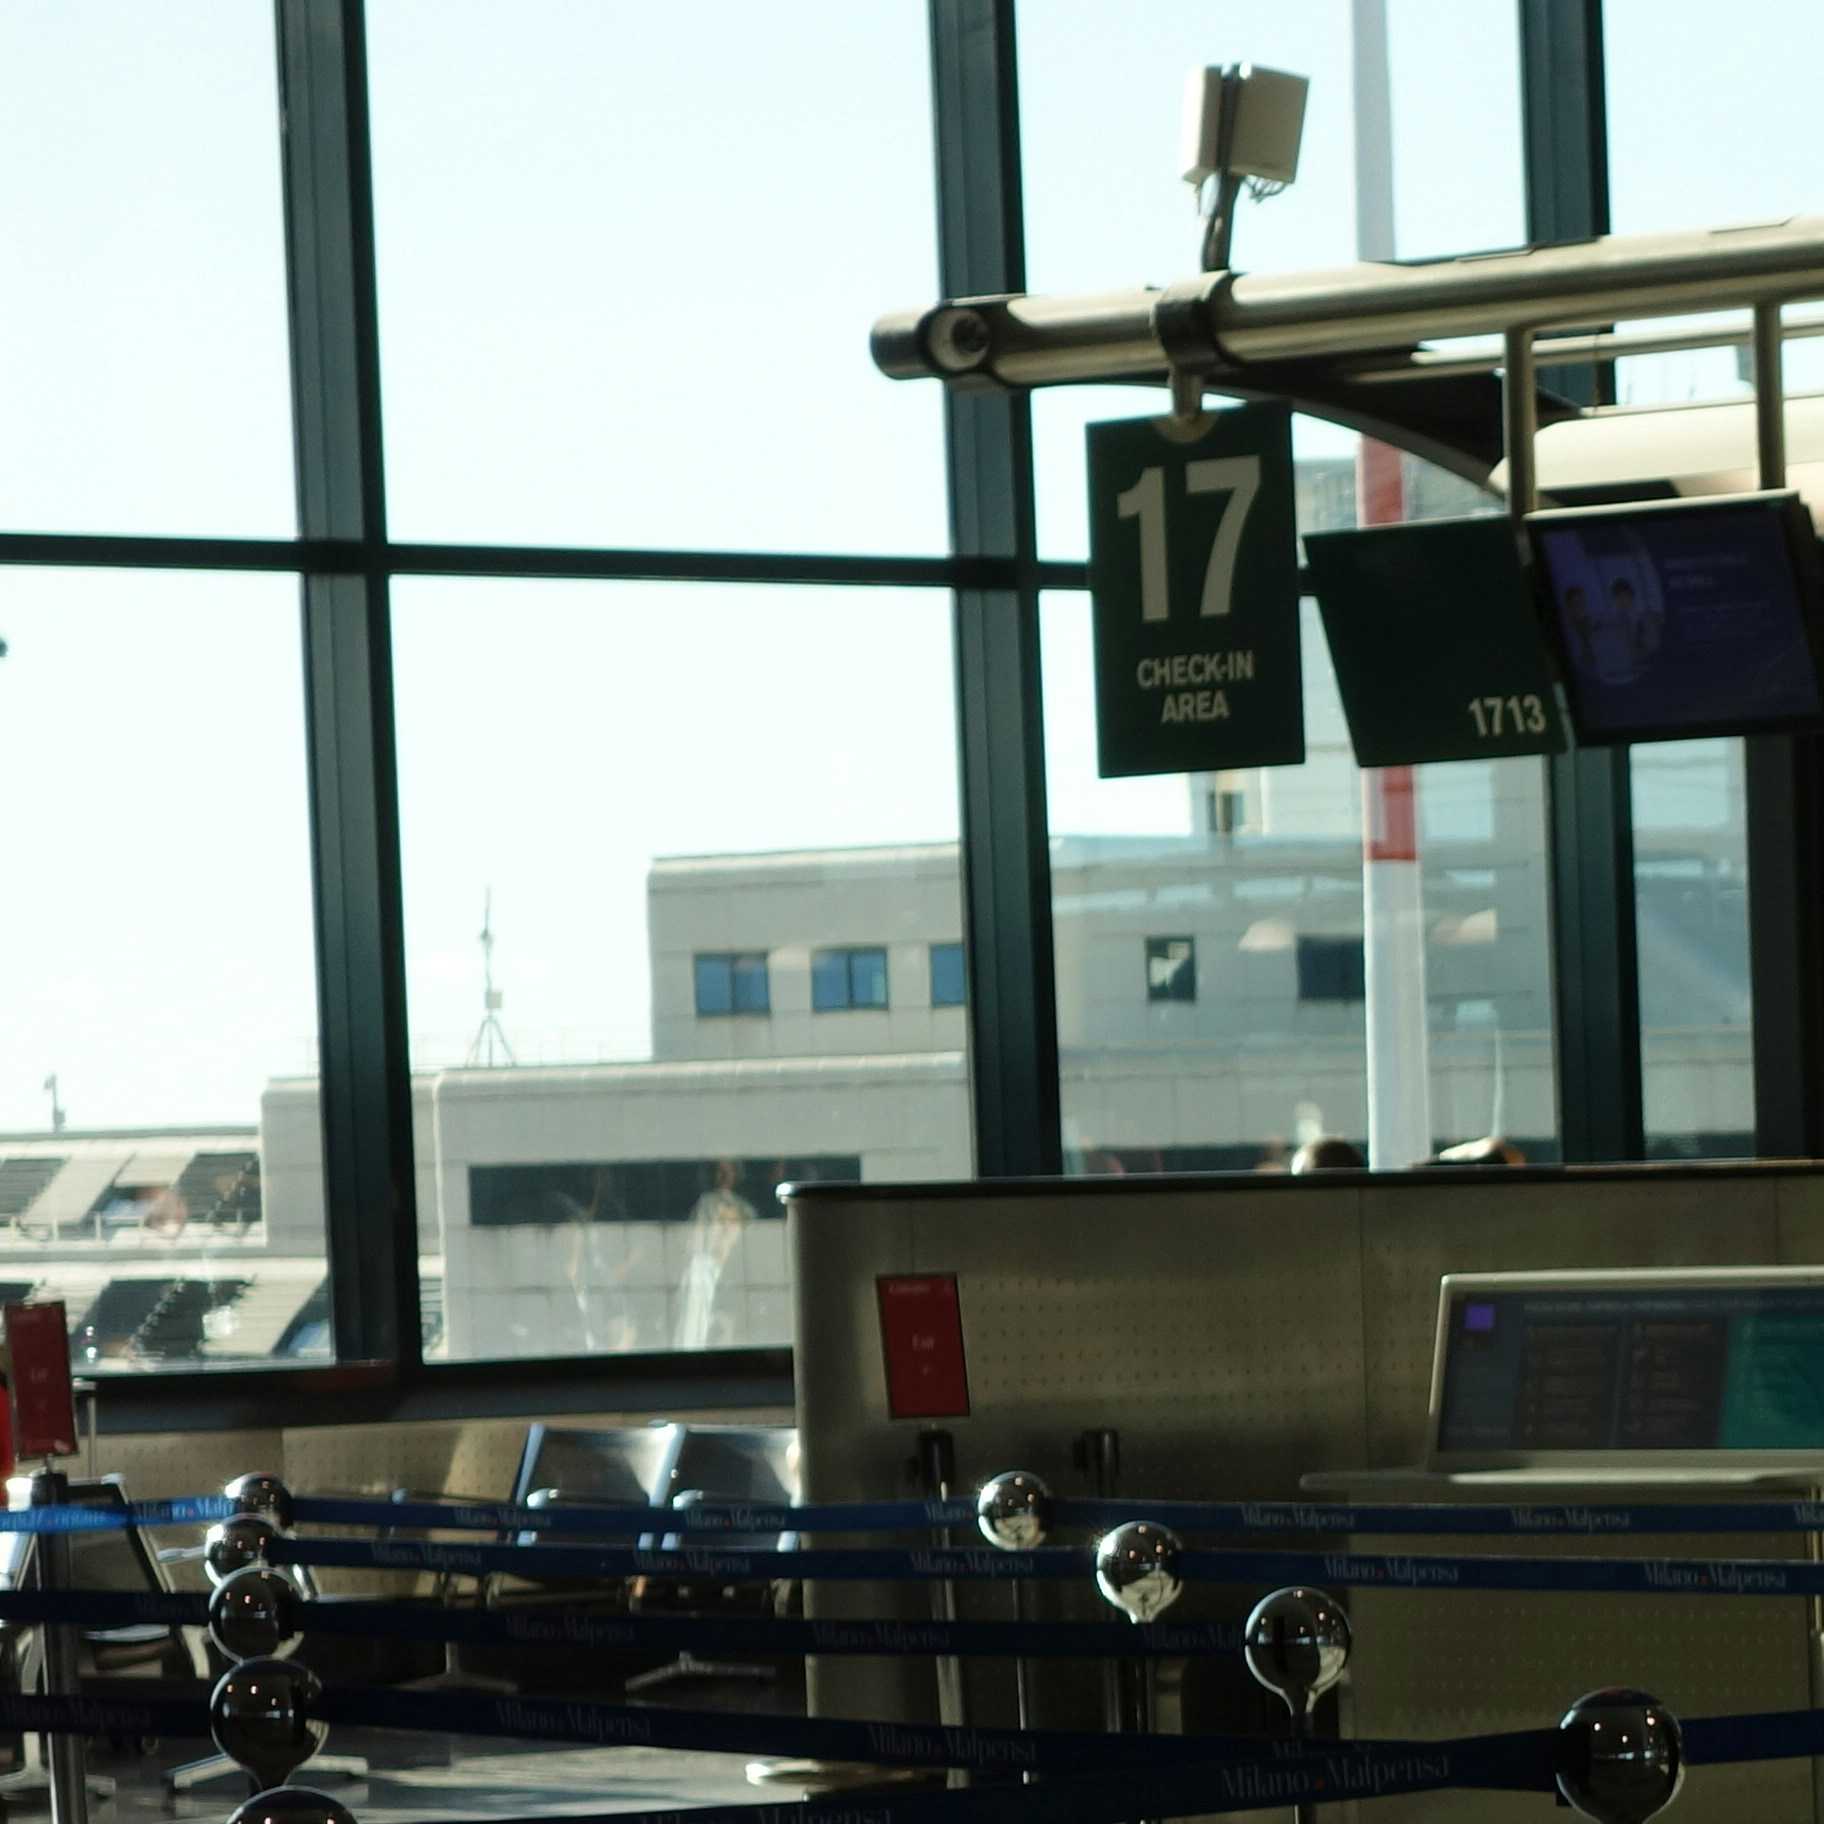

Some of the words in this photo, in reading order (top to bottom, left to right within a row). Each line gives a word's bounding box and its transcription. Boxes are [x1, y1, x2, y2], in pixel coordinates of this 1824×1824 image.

[1116, 454, 1262, 623] 17
[1136, 650, 1255, 689] CHECK-IN
[1161, 690, 1231, 723] AREA
[1468, 693, 1547, 736] 1713
[1239, 1504, 1286, 1528] Milano
[1290, 1506, 1358, 1535] Malpensa
[1511, 1510, 1556, 1529] Milano
[1562, 1509, 1632, 1534] Malpensa
[1323, 1556, 1375, 1581] Milano
[1383, 1557, 1461, 1587] Malpensa
[1641, 1562, 1699, 1585] Milano
[1707, 1563, 1788, 1593] Malpensa
[1220, 1765, 1310, 1801] Milano
[1324, 1753, 1450, 1793] Malpensa
